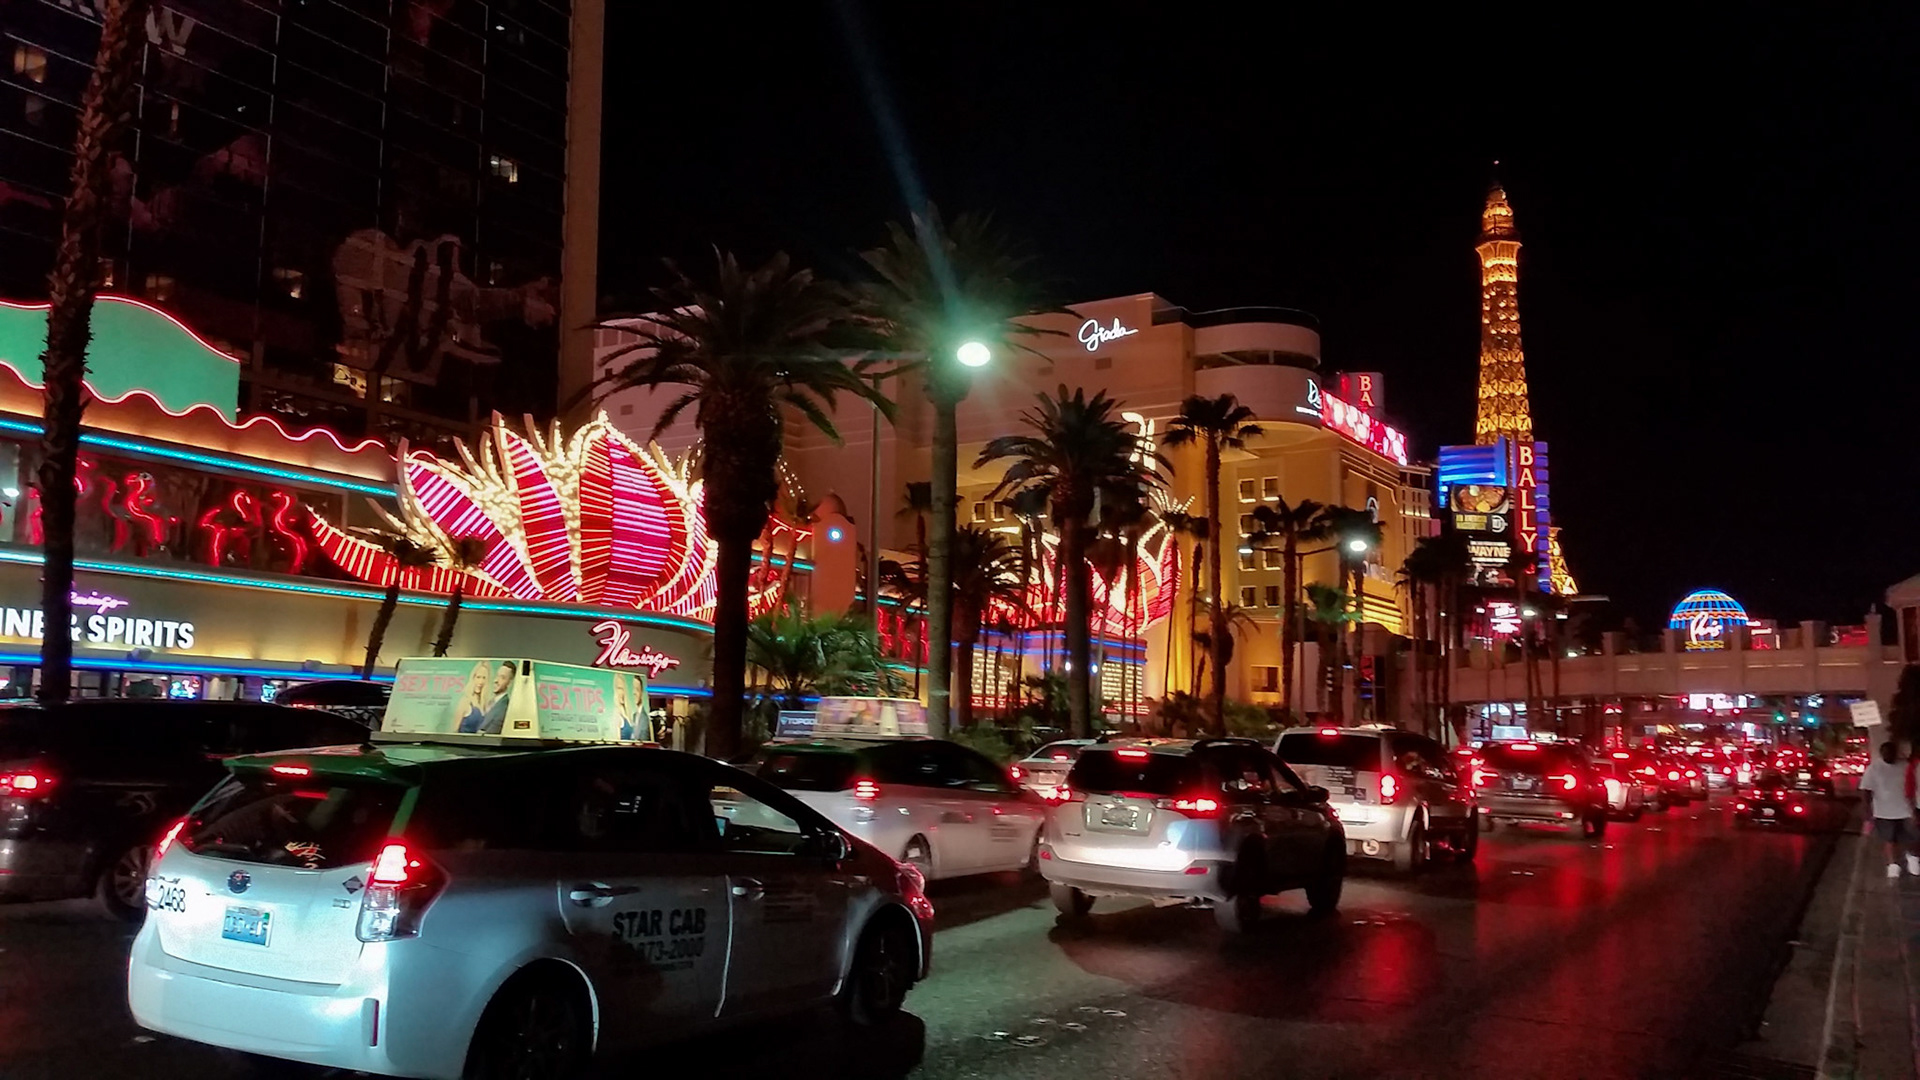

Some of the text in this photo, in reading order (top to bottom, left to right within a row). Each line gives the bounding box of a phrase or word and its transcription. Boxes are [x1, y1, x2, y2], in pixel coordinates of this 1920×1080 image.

[1078, 317, 1139, 352] Giada
[1467, 545, 1511, 558] WAYNE
[87, 614, 195, 650] SPIRITS
[591, 620, 680, 679] Flamingo
[537, 682, 606, 715] SEX TIPS
[158, 884, 186, 913] 2468
[612, 907, 706, 938] STAR CAB
